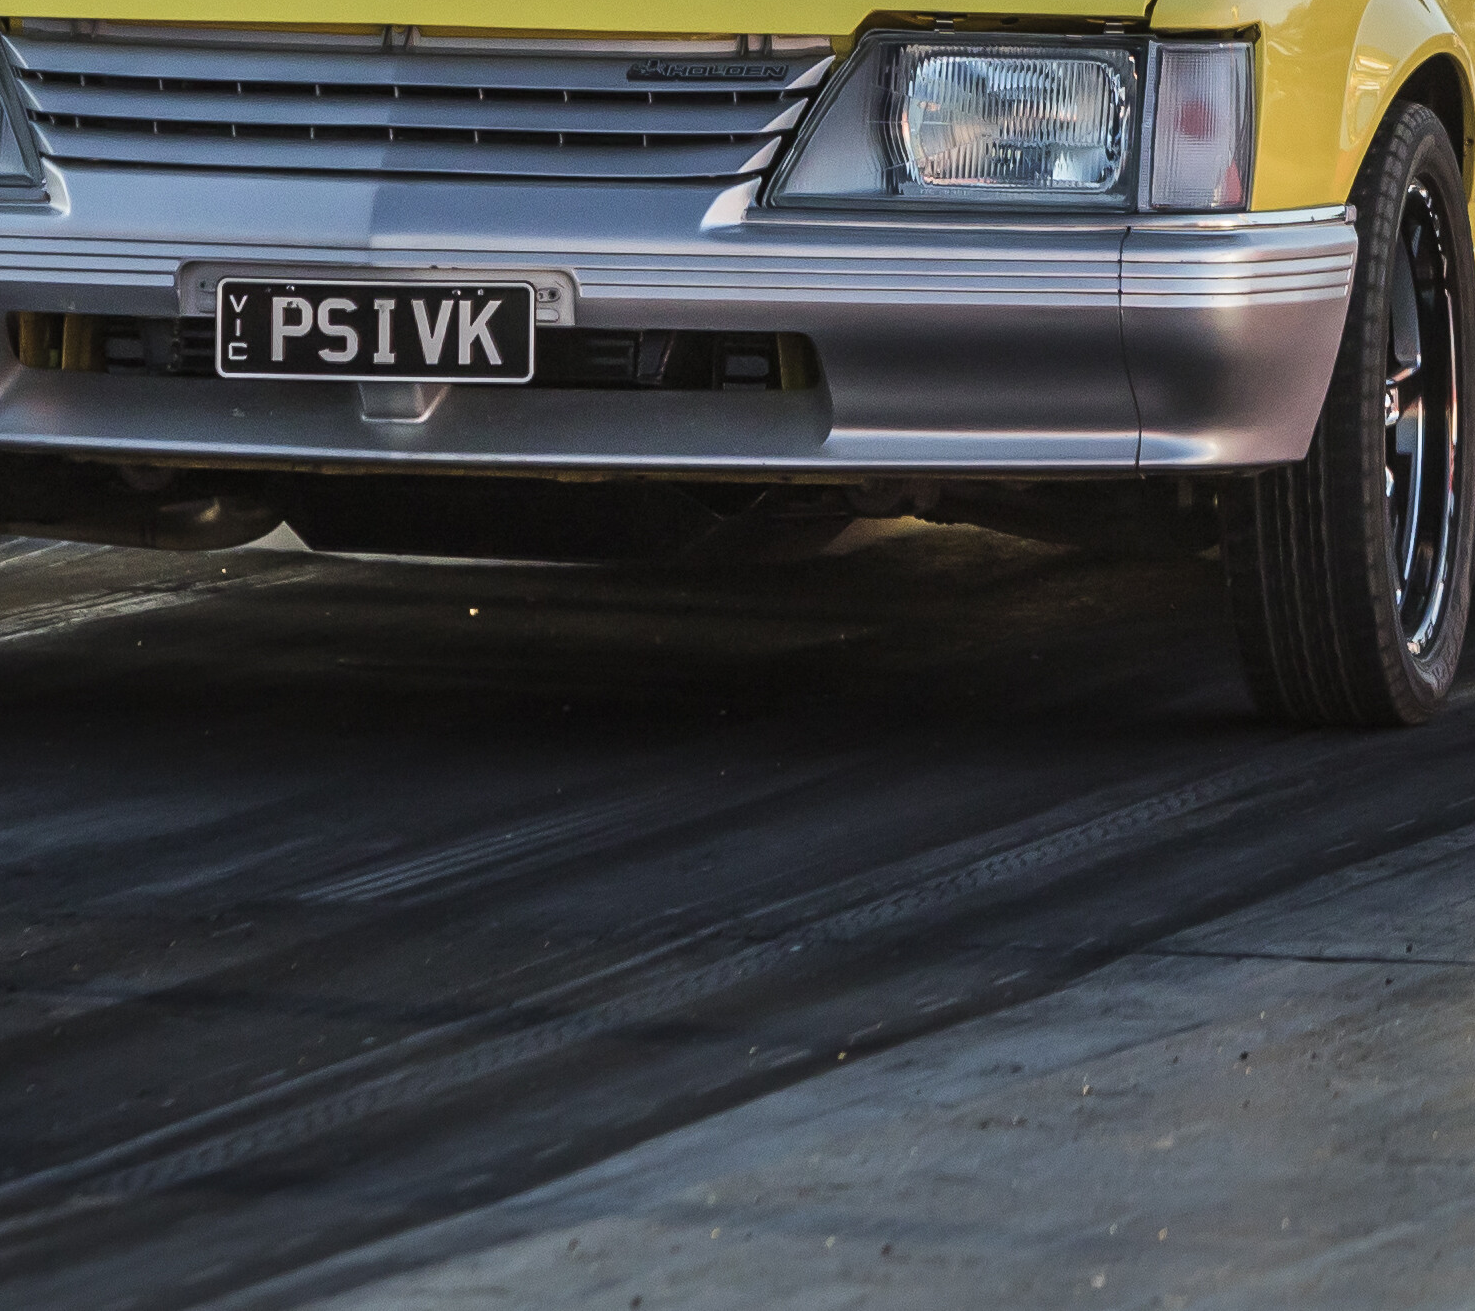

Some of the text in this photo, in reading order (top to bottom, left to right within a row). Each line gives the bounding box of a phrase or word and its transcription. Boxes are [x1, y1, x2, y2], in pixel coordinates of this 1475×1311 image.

[667, 64, 789, 77] HOLDEN
[228, 294, 248, 361] VIC
[271, 296, 503, 366] PSIVK
